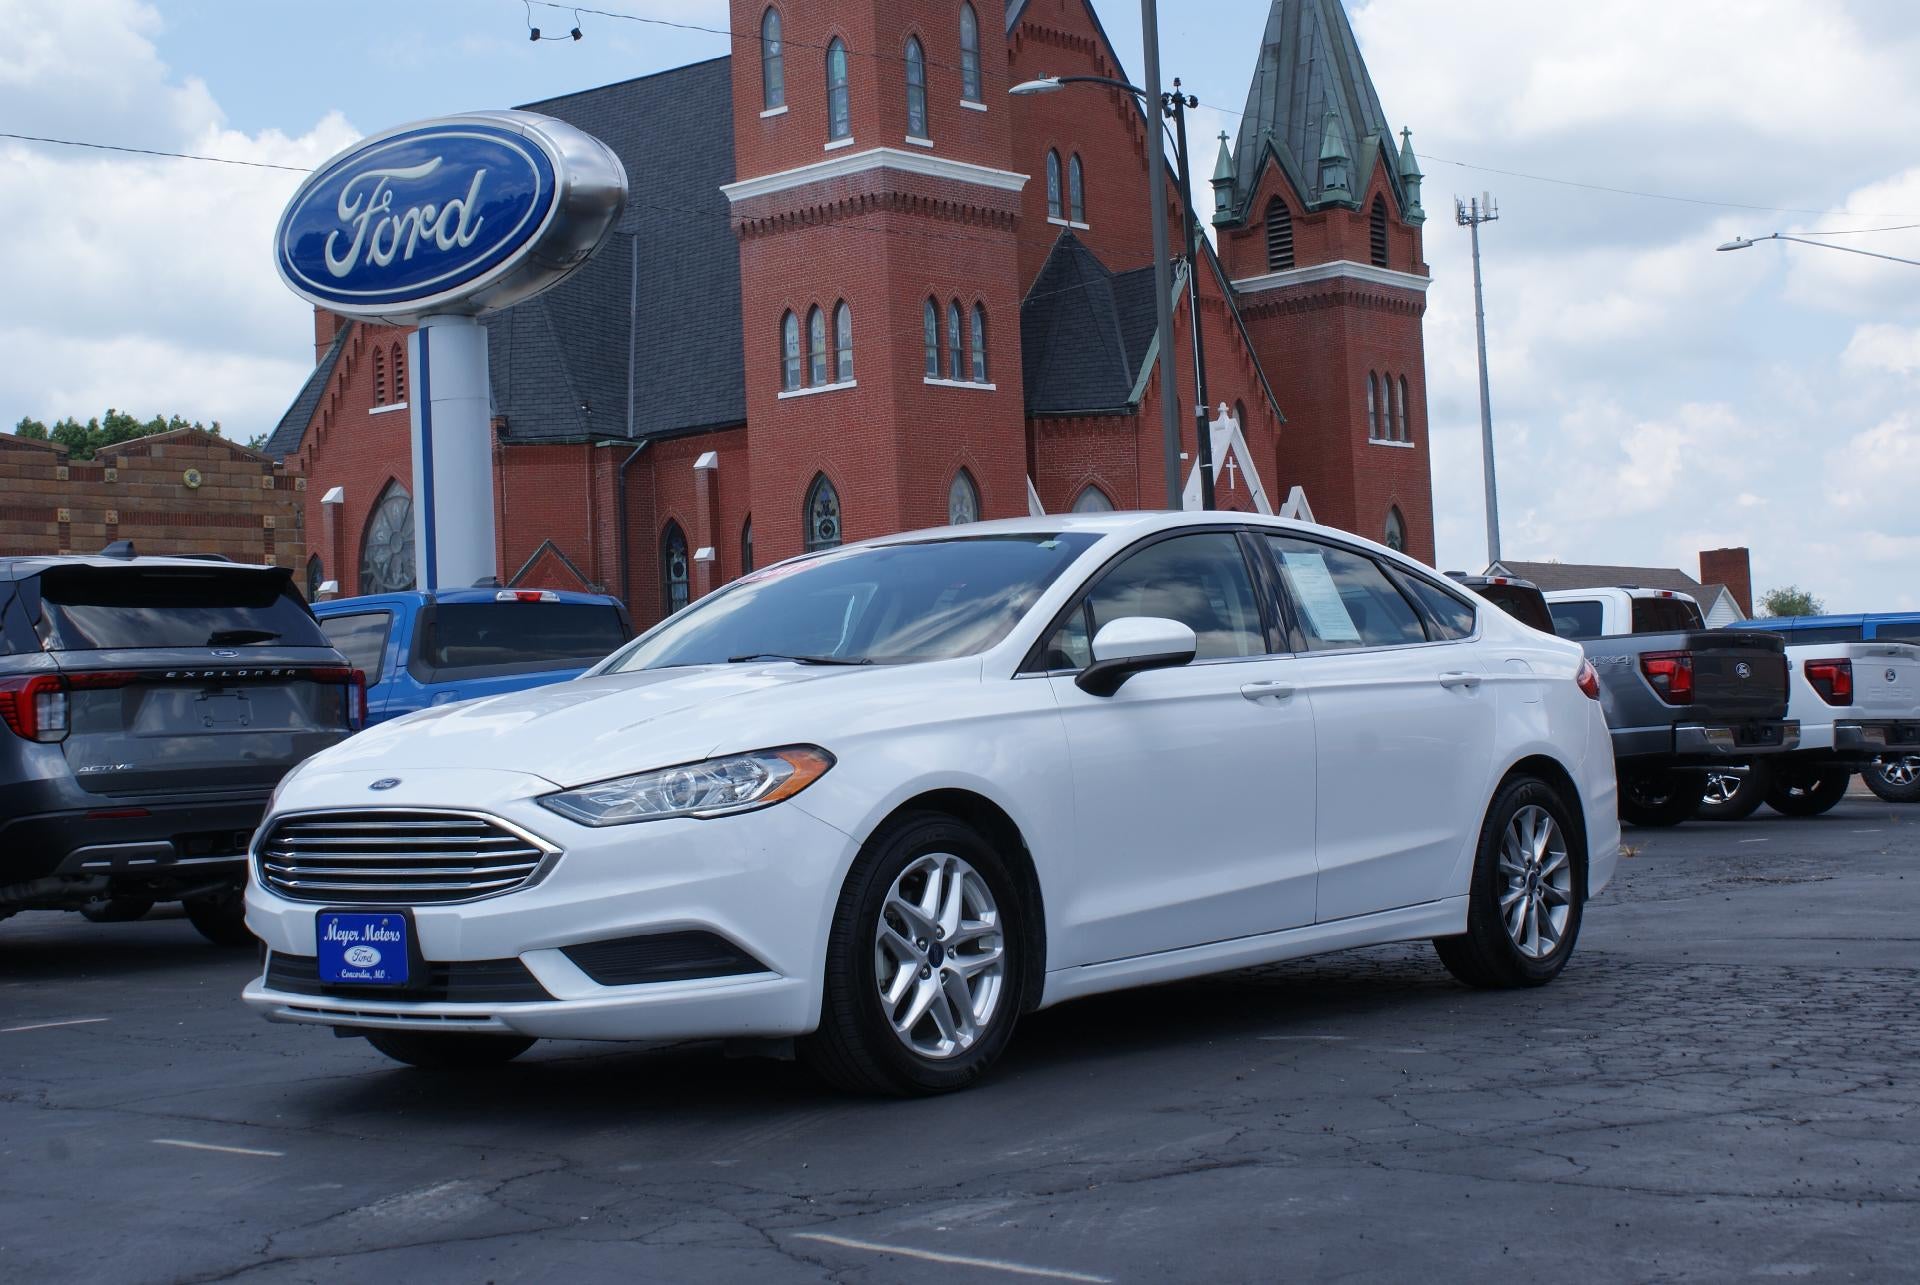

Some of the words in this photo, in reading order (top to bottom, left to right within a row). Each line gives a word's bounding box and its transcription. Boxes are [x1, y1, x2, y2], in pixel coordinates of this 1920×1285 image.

[325, 156, 487, 278] Ford
[166, 669, 296, 678] EXPLORER
[78, 763, 136, 772] ACTIVE
[324, 923, 360, 947] Meyer
[361, 924, 401, 942] Motors
[352, 948, 374, 963] Ford
[341, 968, 373, 980] Concordia,
